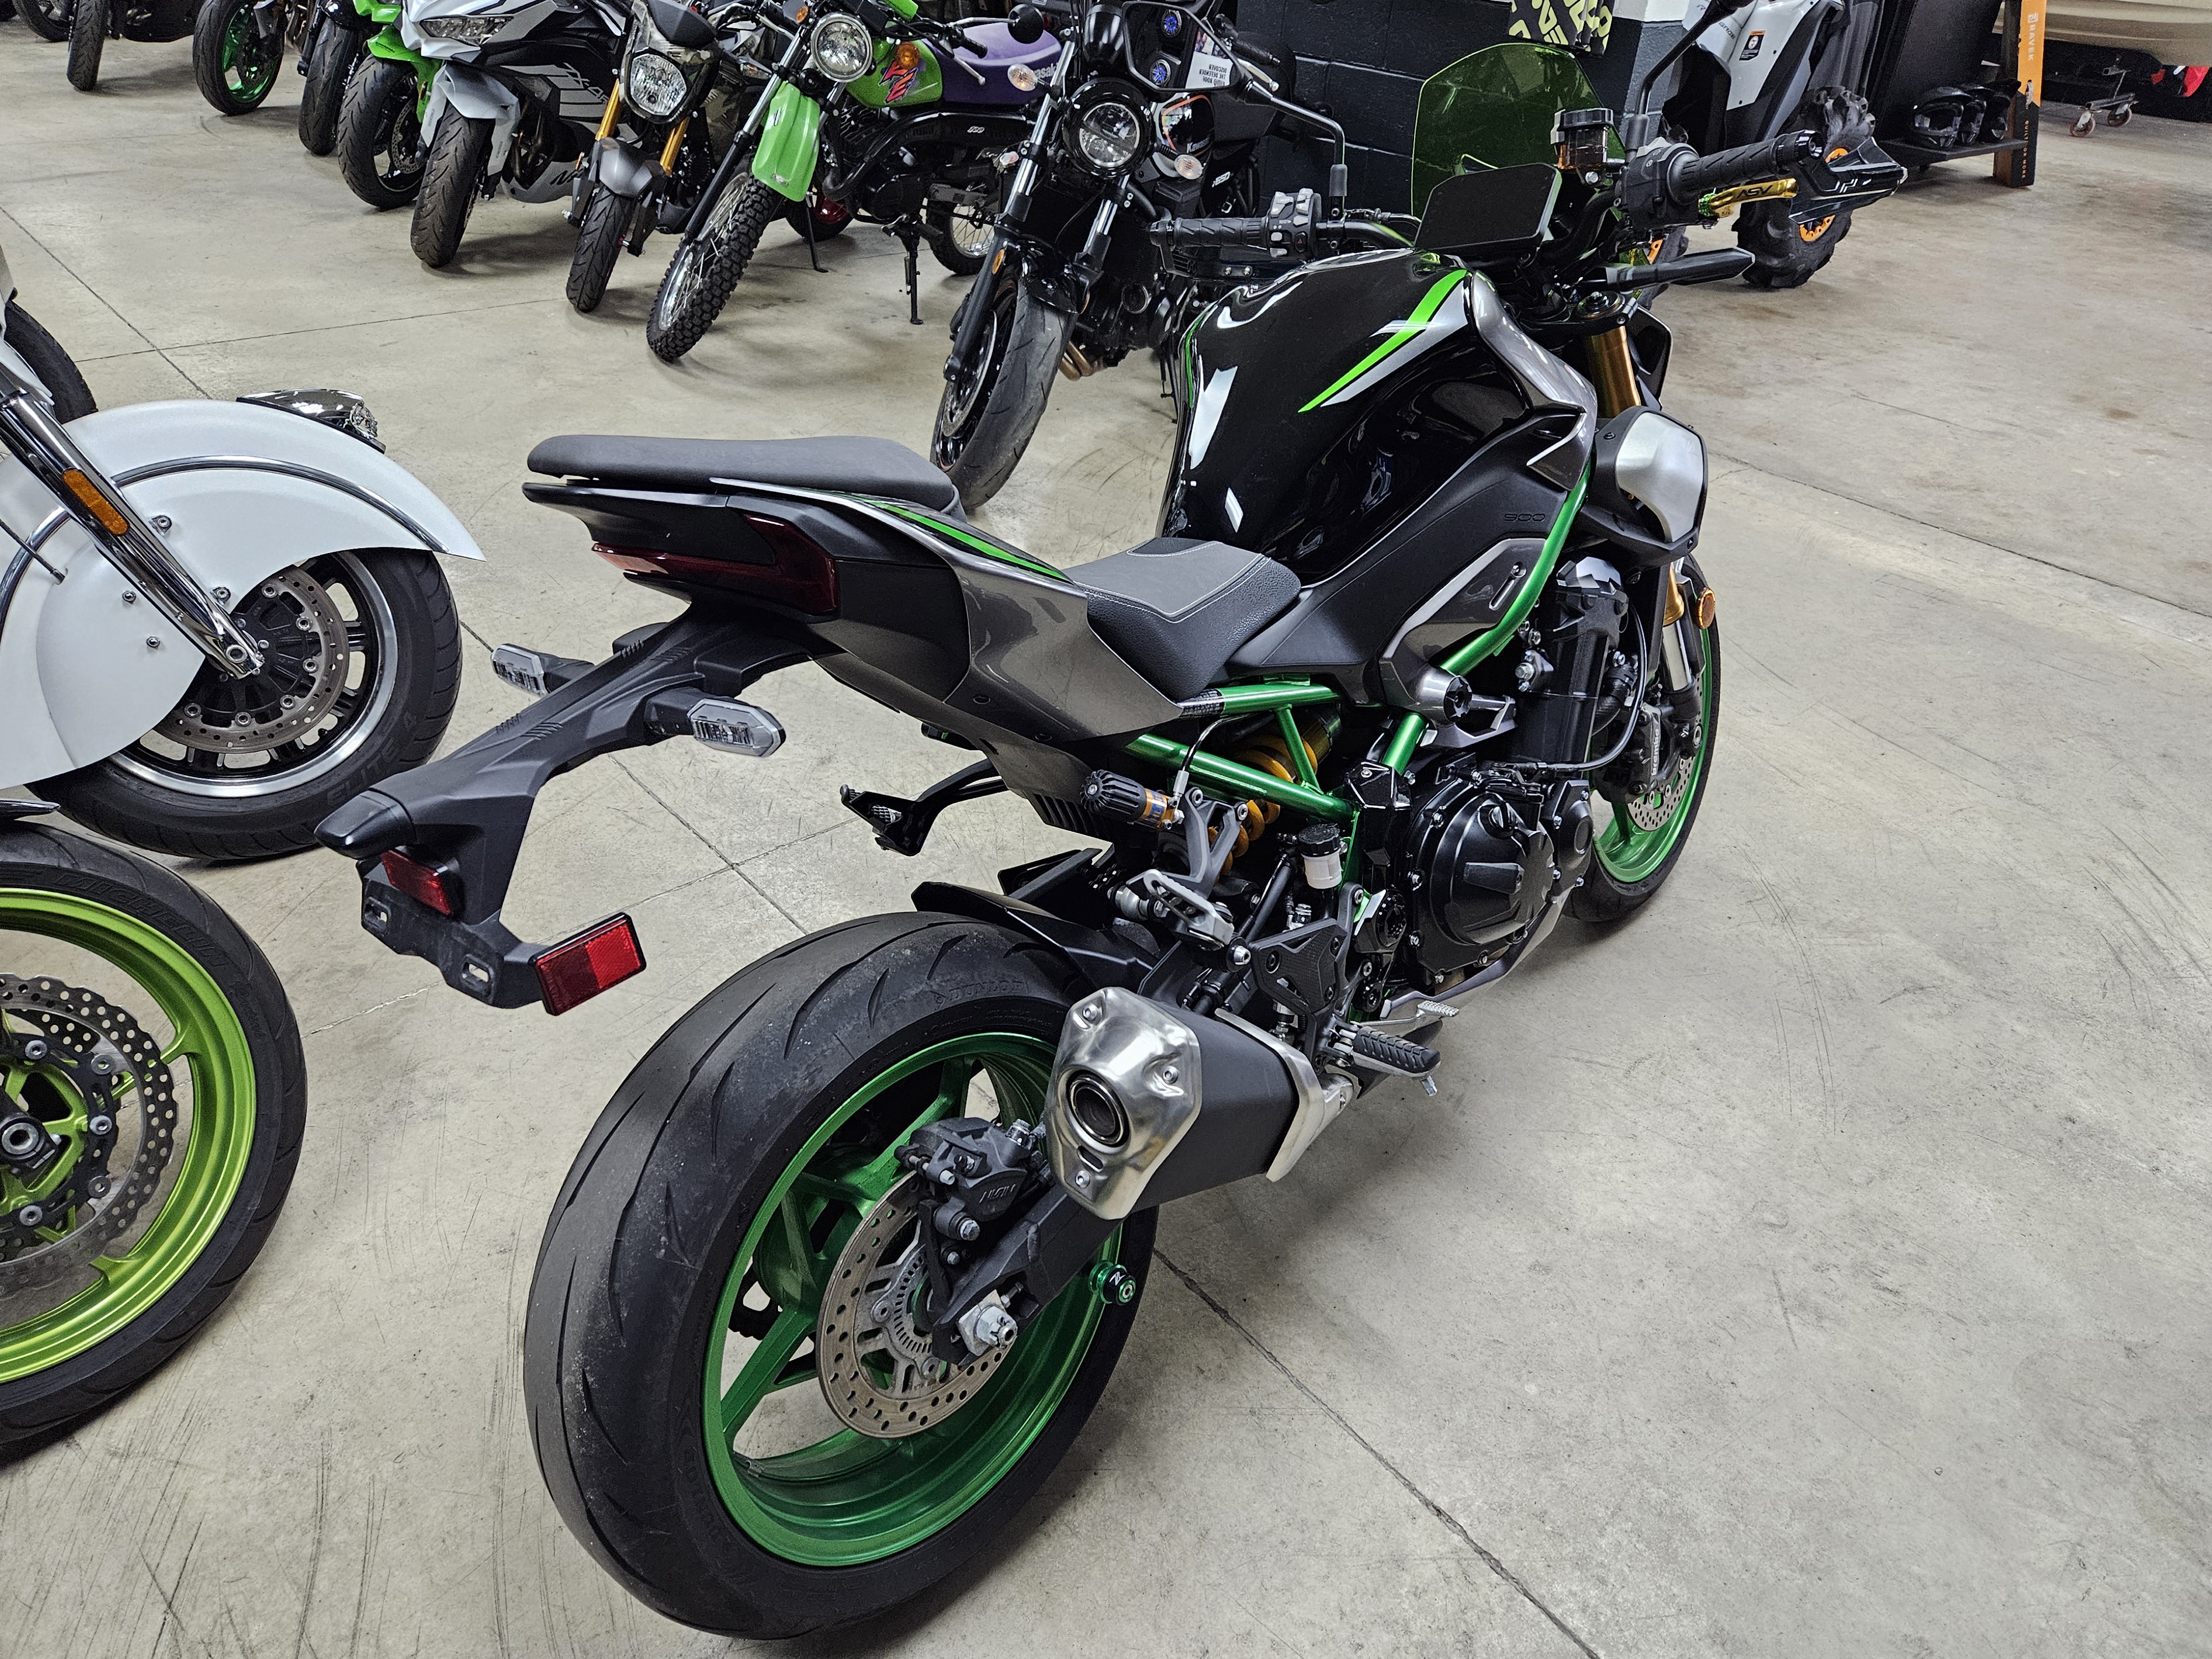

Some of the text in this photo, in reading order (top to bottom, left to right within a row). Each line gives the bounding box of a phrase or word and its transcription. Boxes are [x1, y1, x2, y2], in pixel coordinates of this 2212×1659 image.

[1737, 184, 1773, 198] ASV
[1504, 513, 1546, 522] 900
[1651, 728, 1660, 776] brembo
[53, 872, 229, 968] MICHELIN
